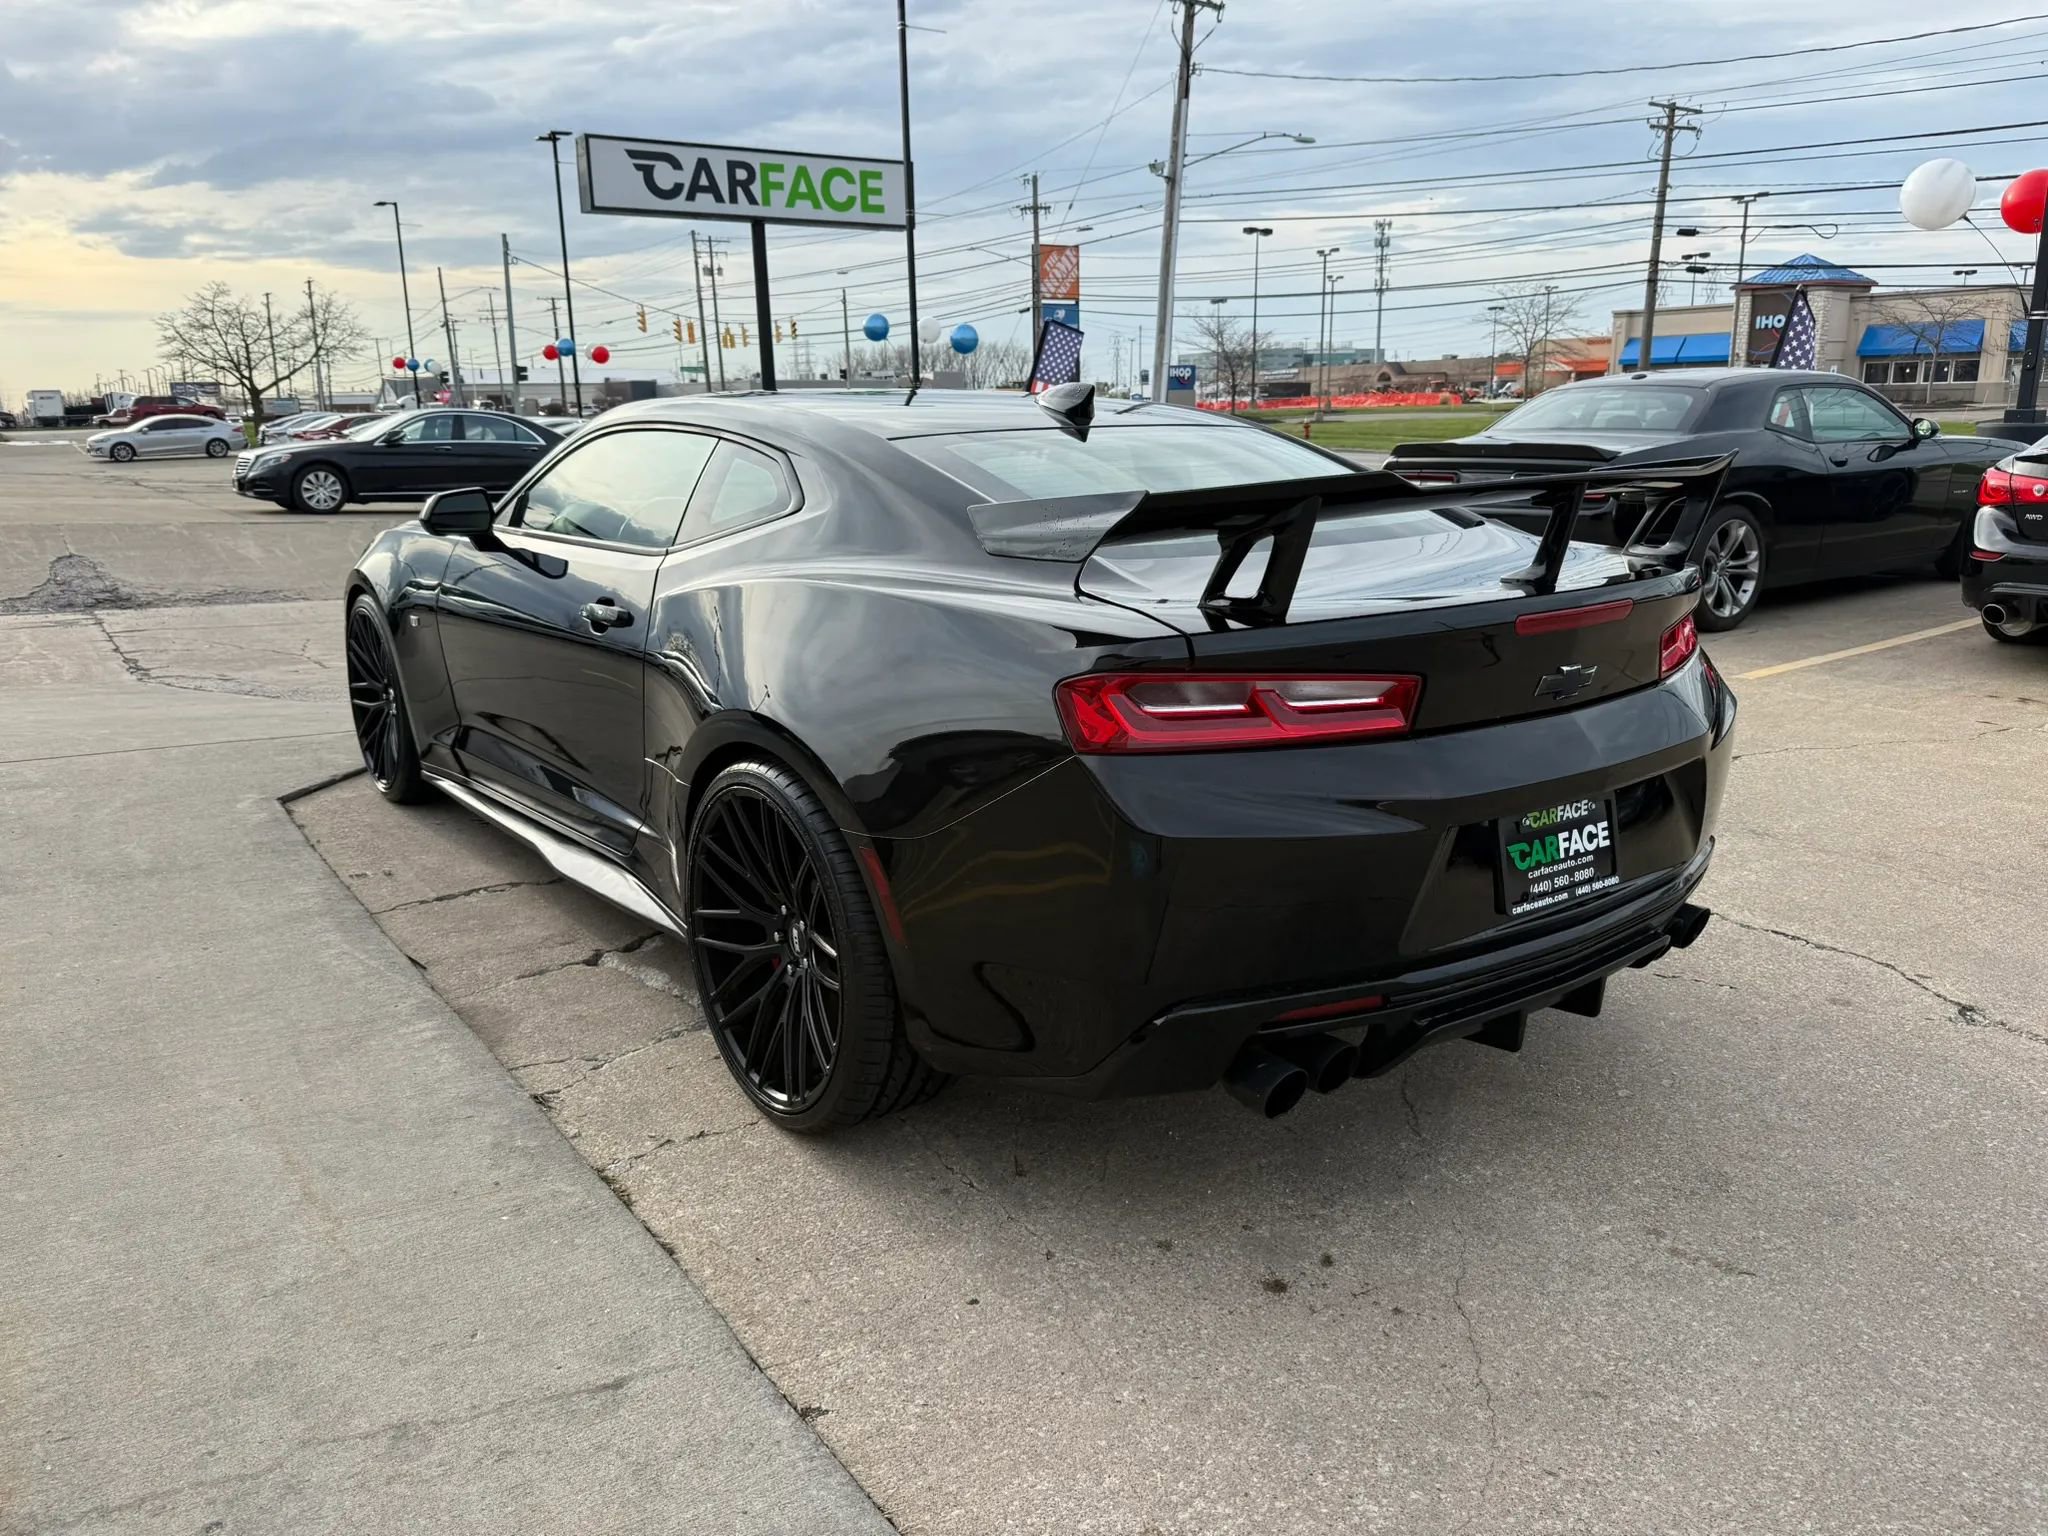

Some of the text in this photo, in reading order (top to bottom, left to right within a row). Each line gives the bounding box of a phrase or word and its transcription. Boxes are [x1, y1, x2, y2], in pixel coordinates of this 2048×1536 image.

[625, 149, 885, 214] CARFACE
[1045, 251, 1058, 272] THE
[1755, 313, 1786, 329] IHO
[2024, 513, 2043, 521] AWD
[1527, 799, 1589, 828] CARFACE
[1506, 821, 1610, 870] CARFACE
[1528, 855, 1594, 879] carfaceauto.com
[1530, 879, 1552, 894] (440)
[1575, 884, 1591, 897] (440)
[1512, 891, 1568, 915] carfaceauto.com
